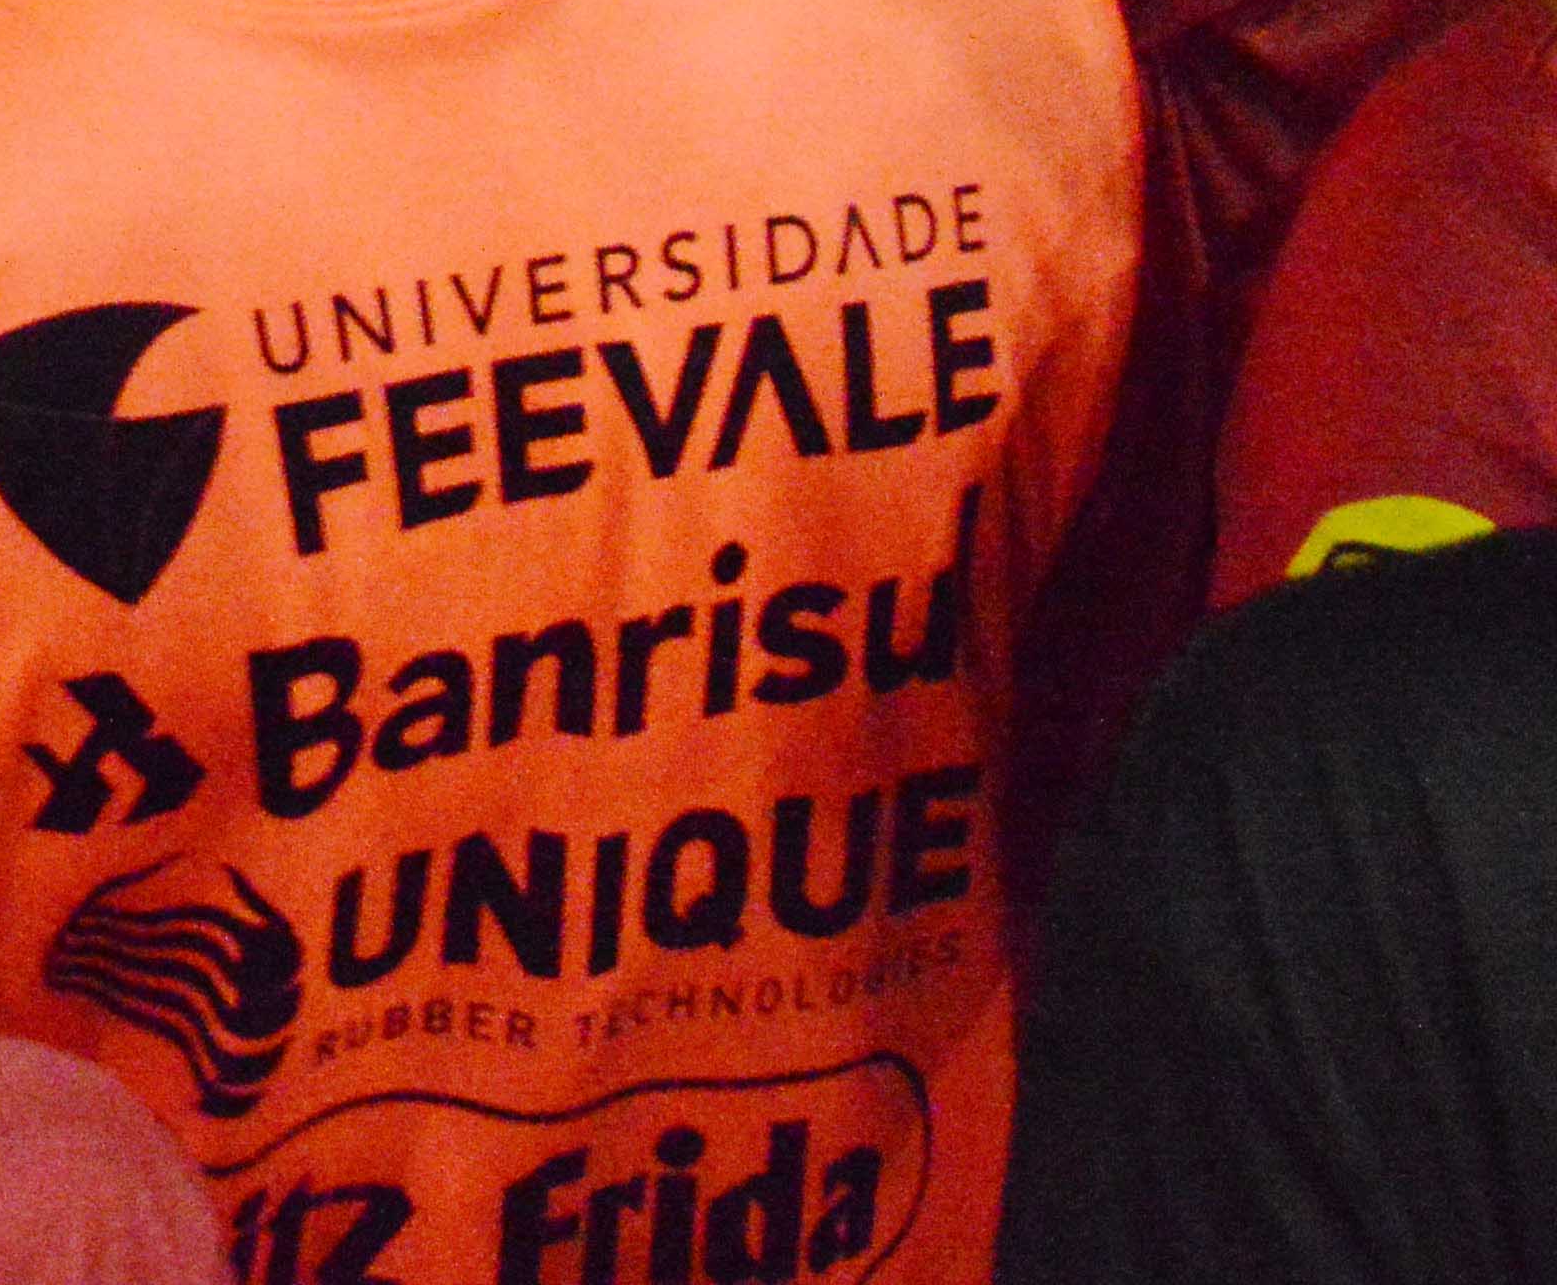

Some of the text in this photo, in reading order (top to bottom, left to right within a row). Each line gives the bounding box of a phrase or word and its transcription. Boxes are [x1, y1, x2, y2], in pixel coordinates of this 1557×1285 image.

[253, 182, 989, 376] UNIVERSIDADE
[271, 277, 1002, 557] FEEVALE
[326, 763, 984, 990] UNIQUE
[315, 994, 538, 1066] RUBBER
